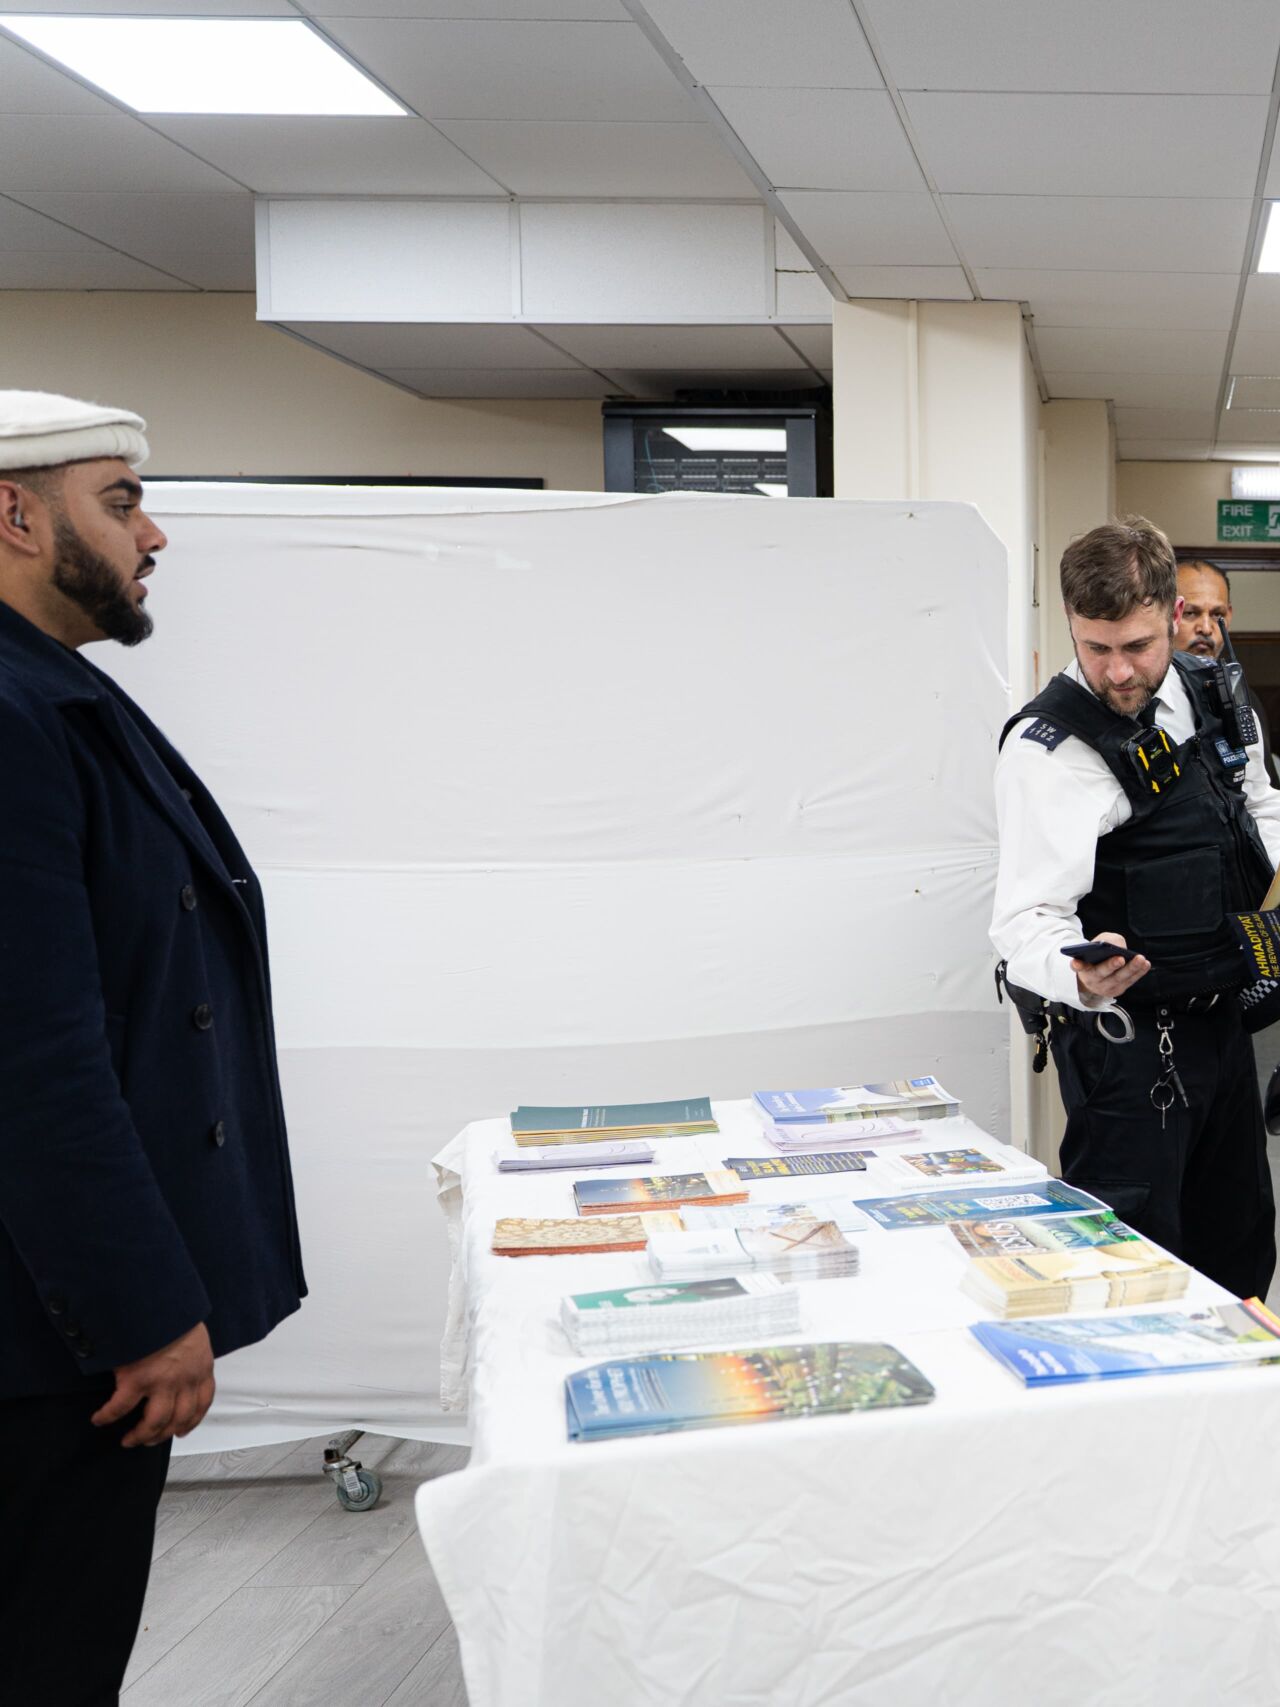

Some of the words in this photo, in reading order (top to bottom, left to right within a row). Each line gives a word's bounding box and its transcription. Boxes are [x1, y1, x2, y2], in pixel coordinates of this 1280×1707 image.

[1222, 504, 1254, 516] FIRE
[1222, 525, 1254, 537] EXIT
[1040, 724, 1057, 733] SW
[1237, 915, 1272, 977] AHMADIYYAT
[1265, 937, 1277, 964] REVIVAL
[1271, 964, 1280, 978] THE
